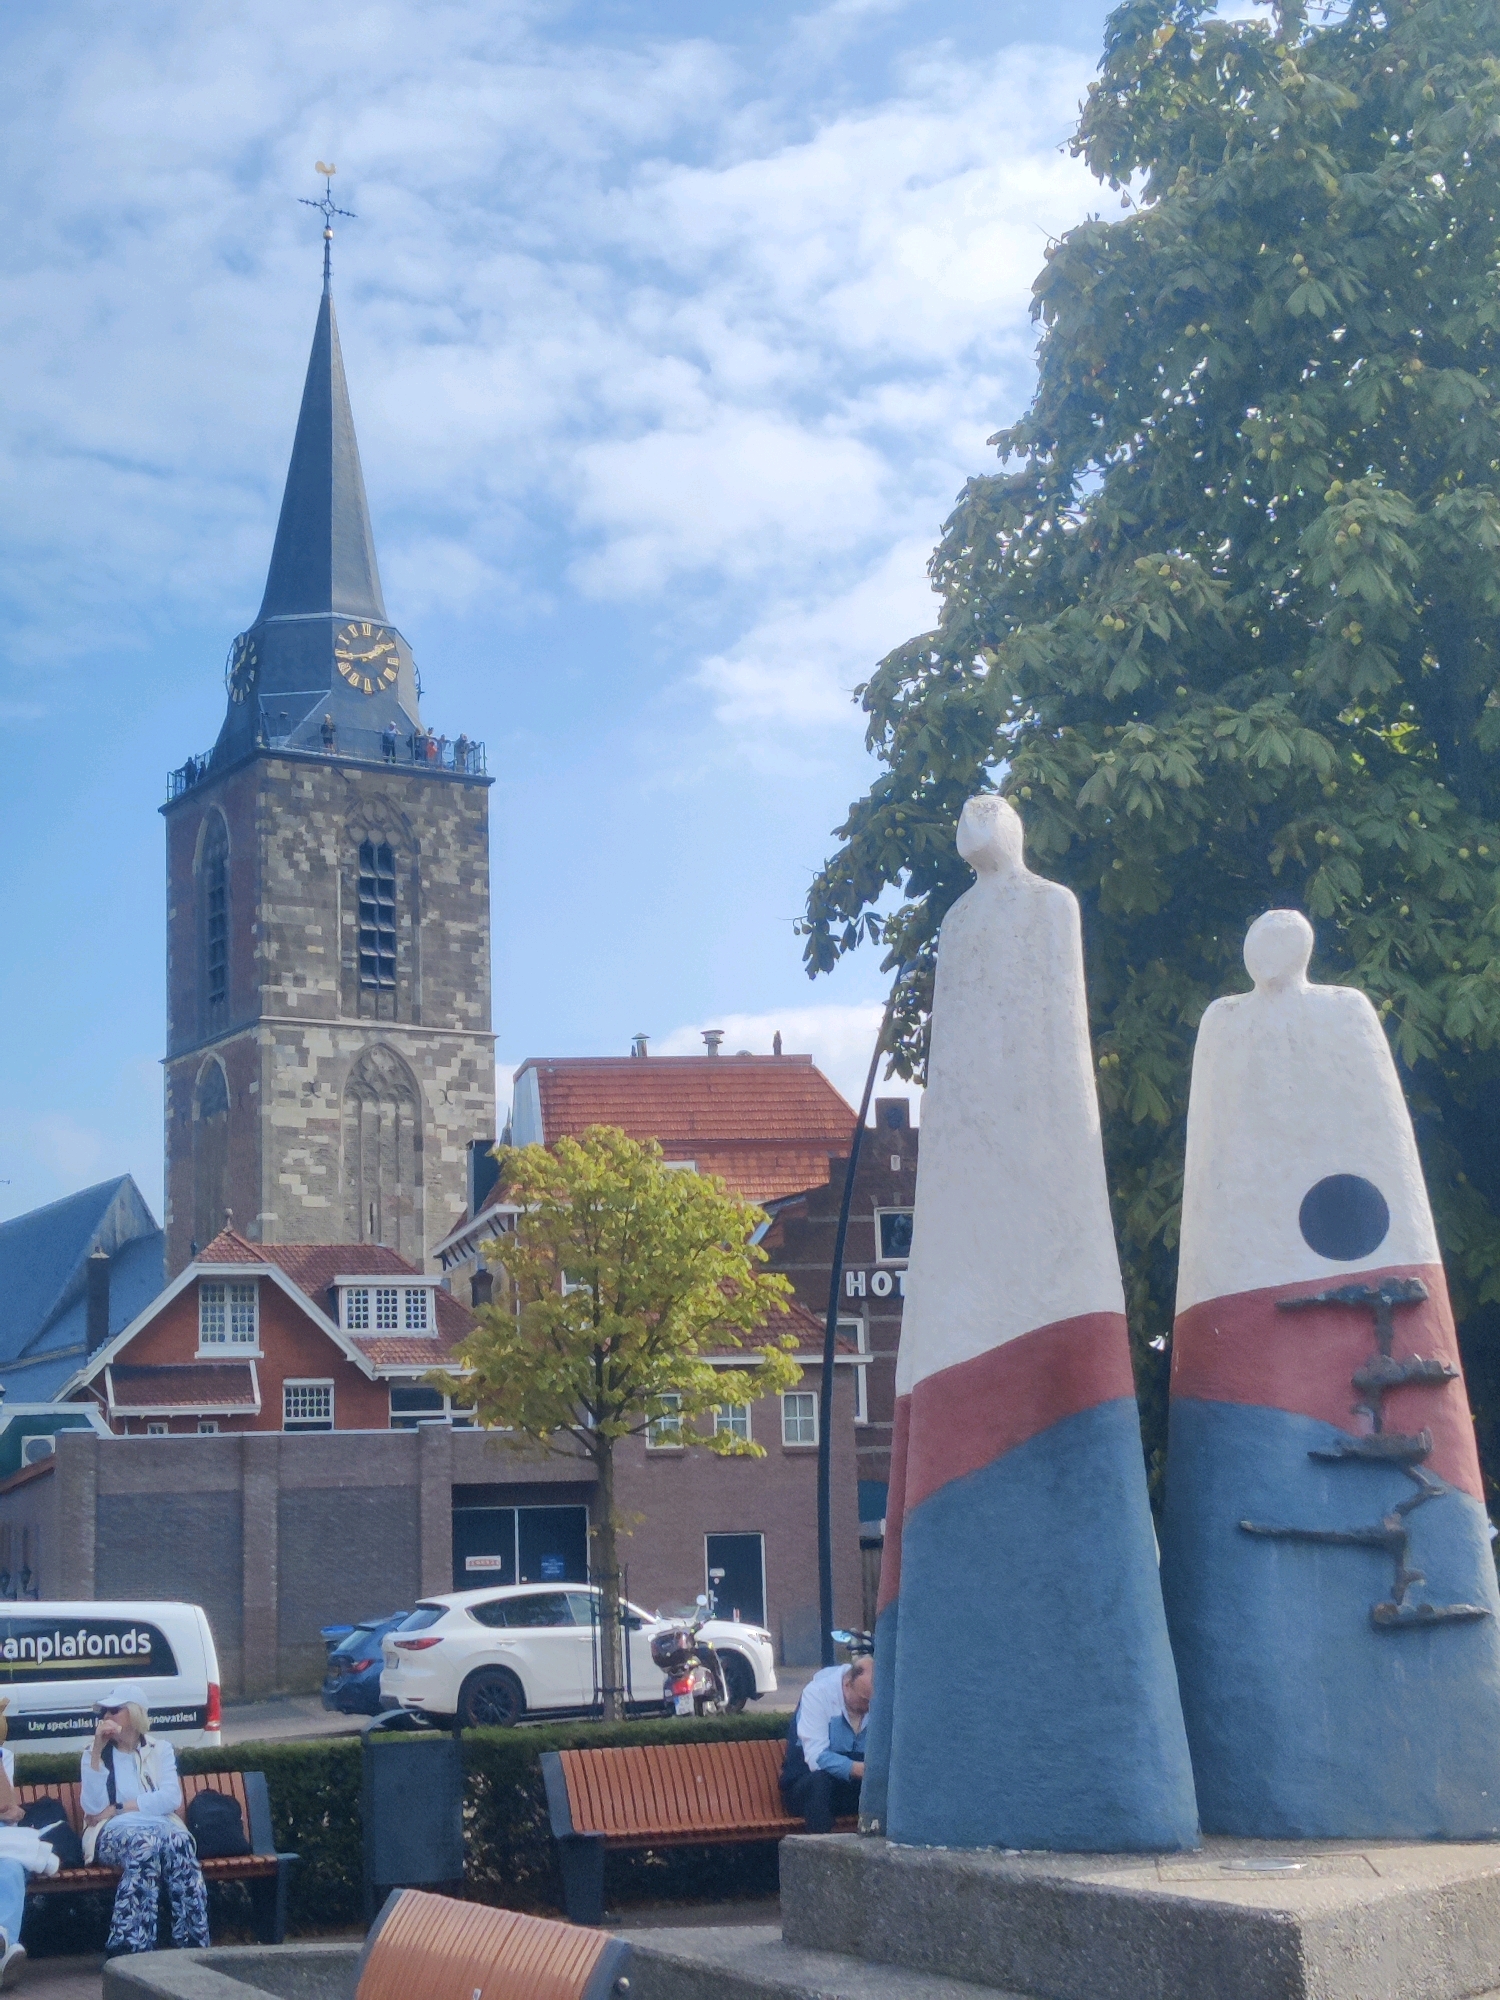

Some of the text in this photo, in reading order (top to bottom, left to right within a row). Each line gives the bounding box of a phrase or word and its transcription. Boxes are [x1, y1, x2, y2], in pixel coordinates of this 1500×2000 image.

[0, 1628, 152, 1665] anplafonds
[28, 1721, 46, 1732] Uw
[46, 1717, 94, 1732] specialist
